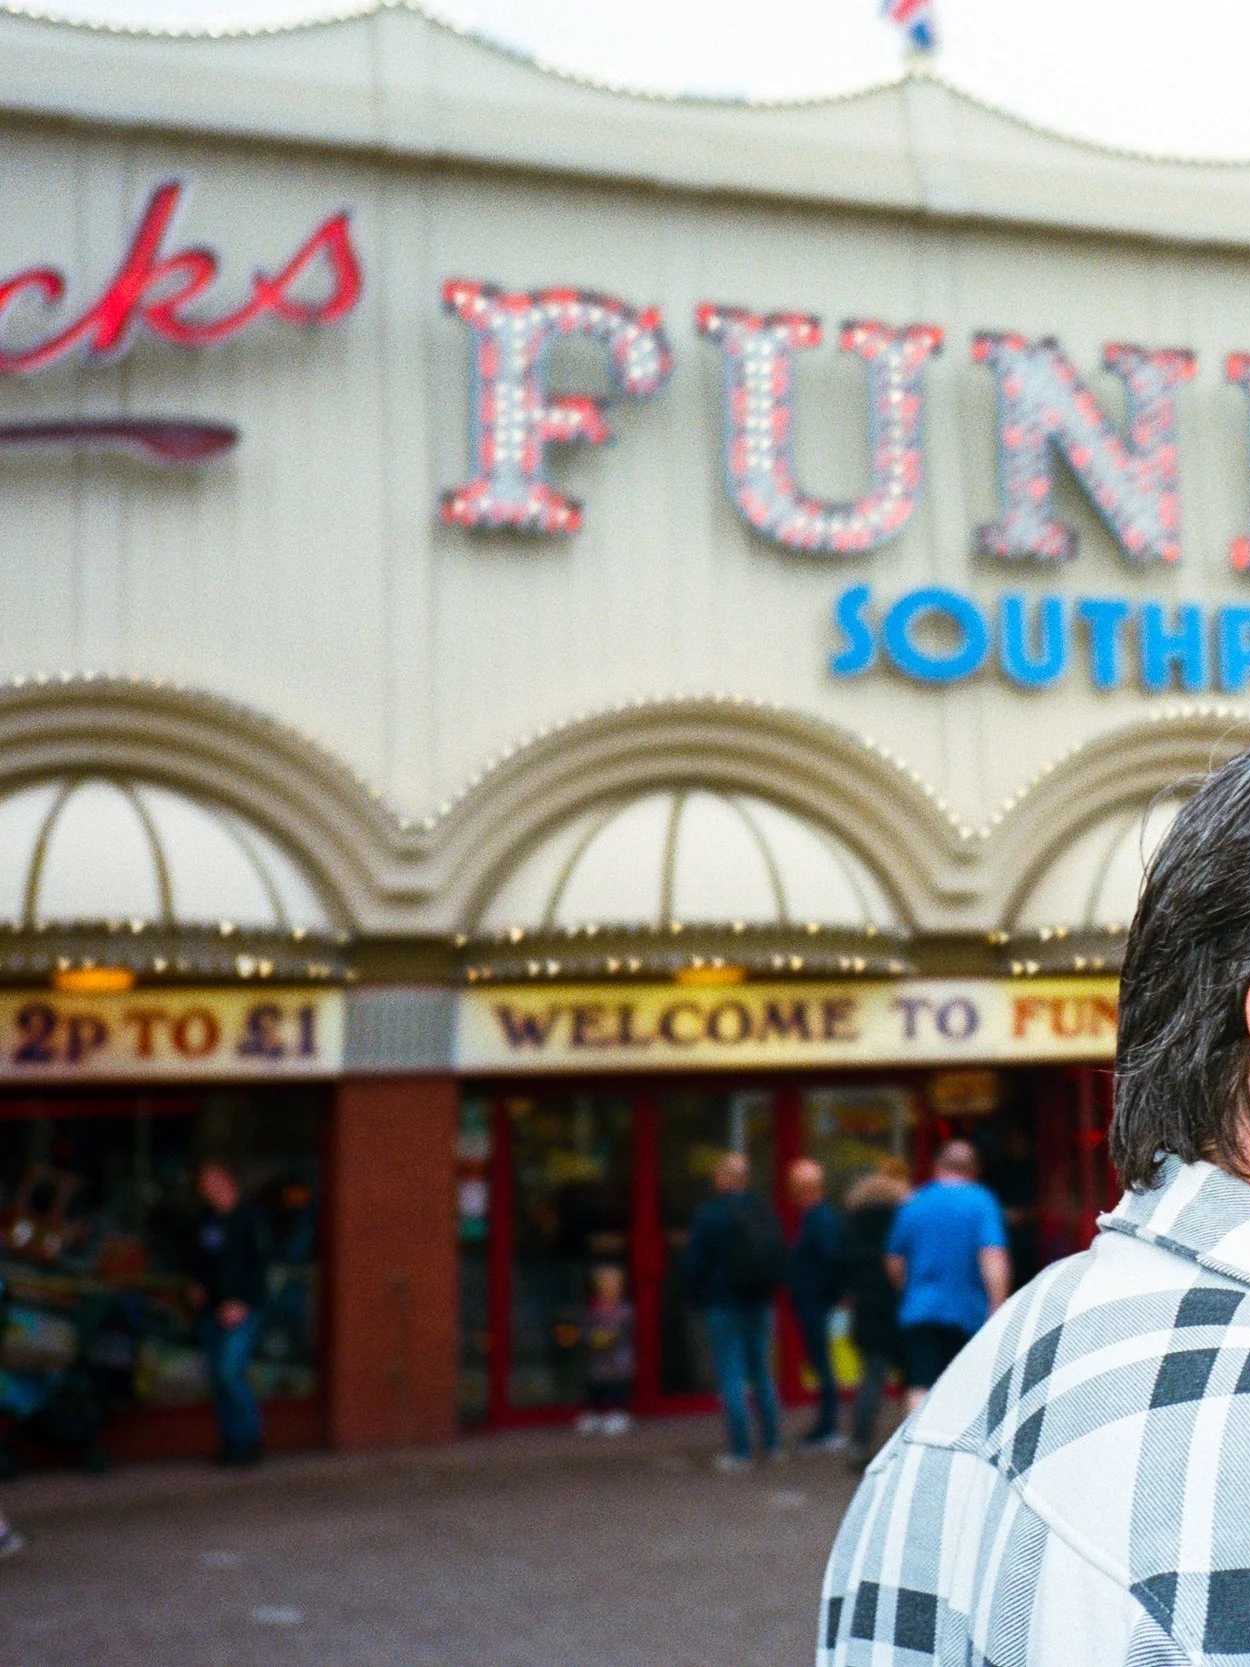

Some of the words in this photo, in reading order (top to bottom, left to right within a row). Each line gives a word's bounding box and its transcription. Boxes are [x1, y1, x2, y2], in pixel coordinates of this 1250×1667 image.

[122, 1008, 220, 1058] TO
[494, 1000, 860, 1050] WELCOME
[894, 996, 980, 1040] TO
